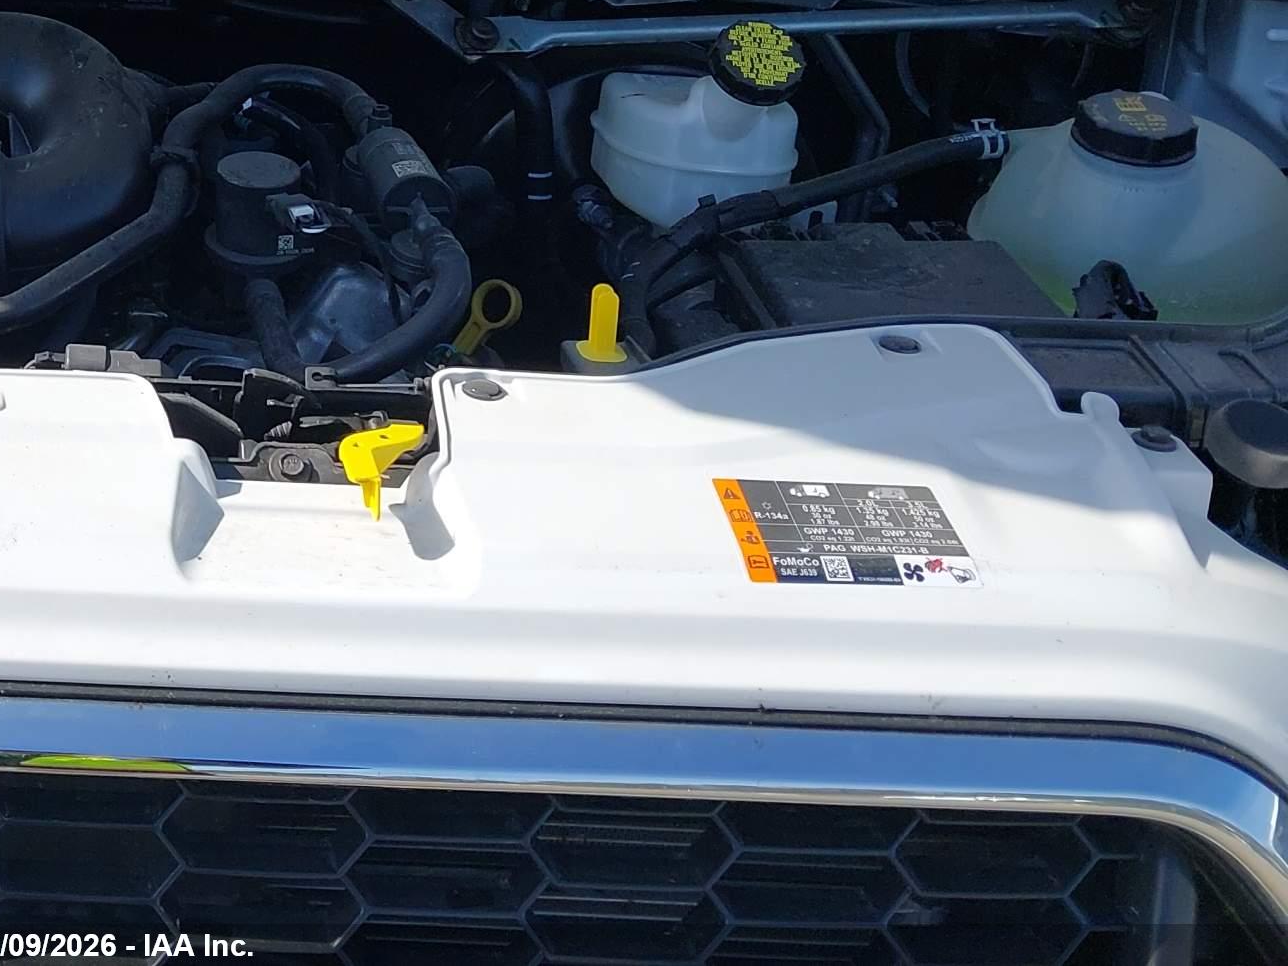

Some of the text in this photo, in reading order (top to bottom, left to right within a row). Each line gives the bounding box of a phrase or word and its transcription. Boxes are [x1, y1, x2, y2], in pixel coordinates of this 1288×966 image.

[802, 504, 836, 515] 0.85 kg
[876, 508, 890, 517] kg
[927, 509, 941, 518] kg
[753, 511, 789, 520] R-134a
[803, 527, 855, 537] GWP 1430
[881, 529, 933, 538] GWP 1430
[823, 544, 929, 555] PAG WSH-M1C231-B
[773, 557, 820, 567] FoMoCo
[781, 568, 818, 577] SAE J639
